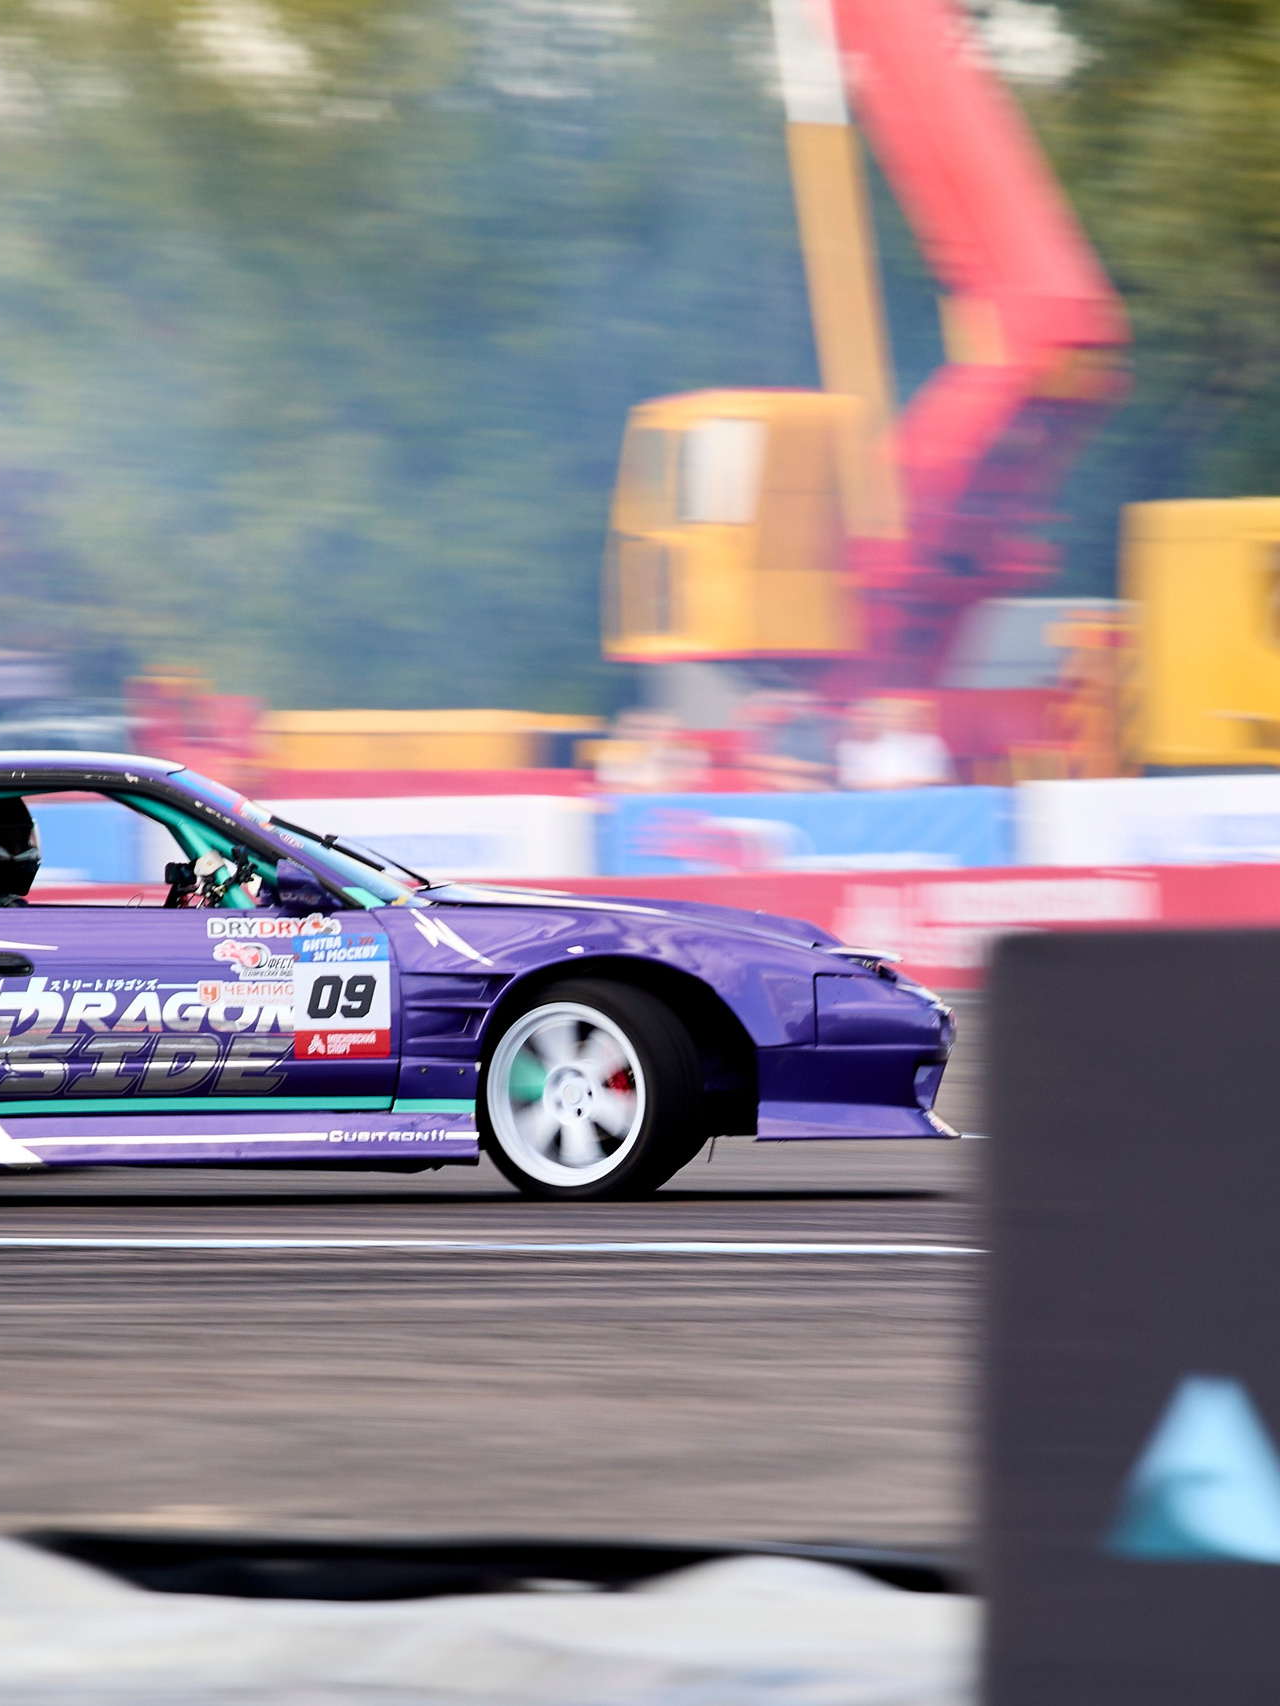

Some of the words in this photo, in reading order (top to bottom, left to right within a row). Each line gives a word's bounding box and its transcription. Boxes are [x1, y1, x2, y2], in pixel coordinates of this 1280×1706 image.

[210, 920, 307, 935] DRYDRY
[302, 936, 342, 953] БИТВА
[312, 951, 325, 962] ЗА
[326, 944, 379, 963] МОСКВУ
[306, 975, 377, 1019] 09
[327, 1031, 376, 1045] МОСКОВСКИЙ
[327, 1043, 350, 1055] СПОРТ
